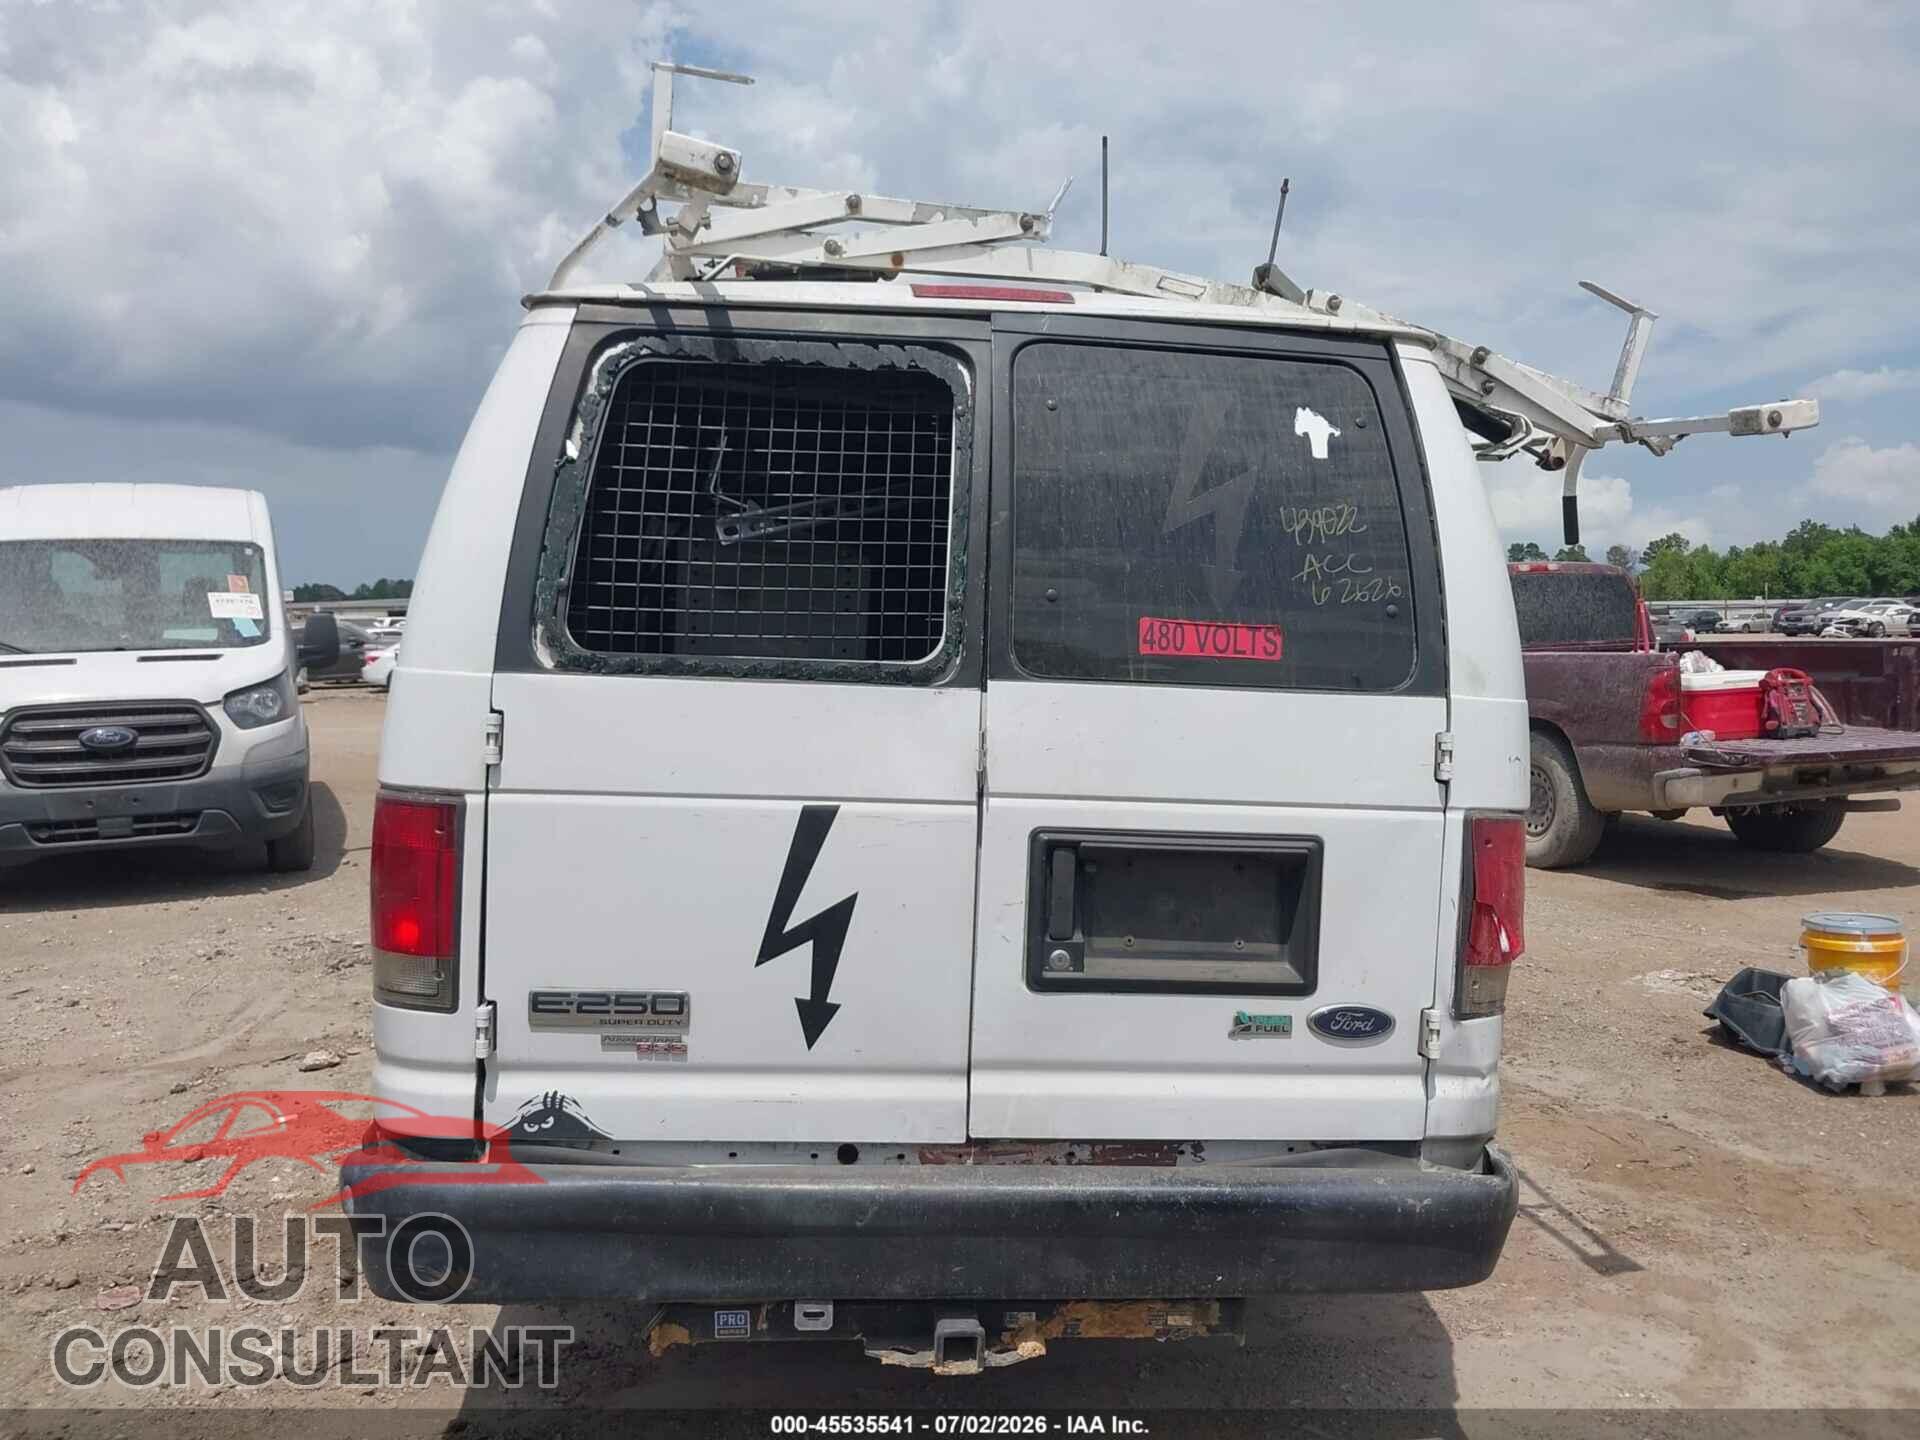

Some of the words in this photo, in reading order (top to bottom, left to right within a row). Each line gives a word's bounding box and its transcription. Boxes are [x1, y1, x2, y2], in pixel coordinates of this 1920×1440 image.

[1291, 553, 1373, 583] ACC
[1142, 622, 1185, 651] 480
[1194, 623, 1278, 656] VOLTS
[531, 991, 685, 1015] E-250
[599, 1018, 643, 1026] SUPER
[646, 1018, 682, 1026] DUTY
[1255, 1024, 1289, 1033] FUEL
[1330, 1011, 1375, 1031] Ford
[719, 1314, 745, 1326] PRO
